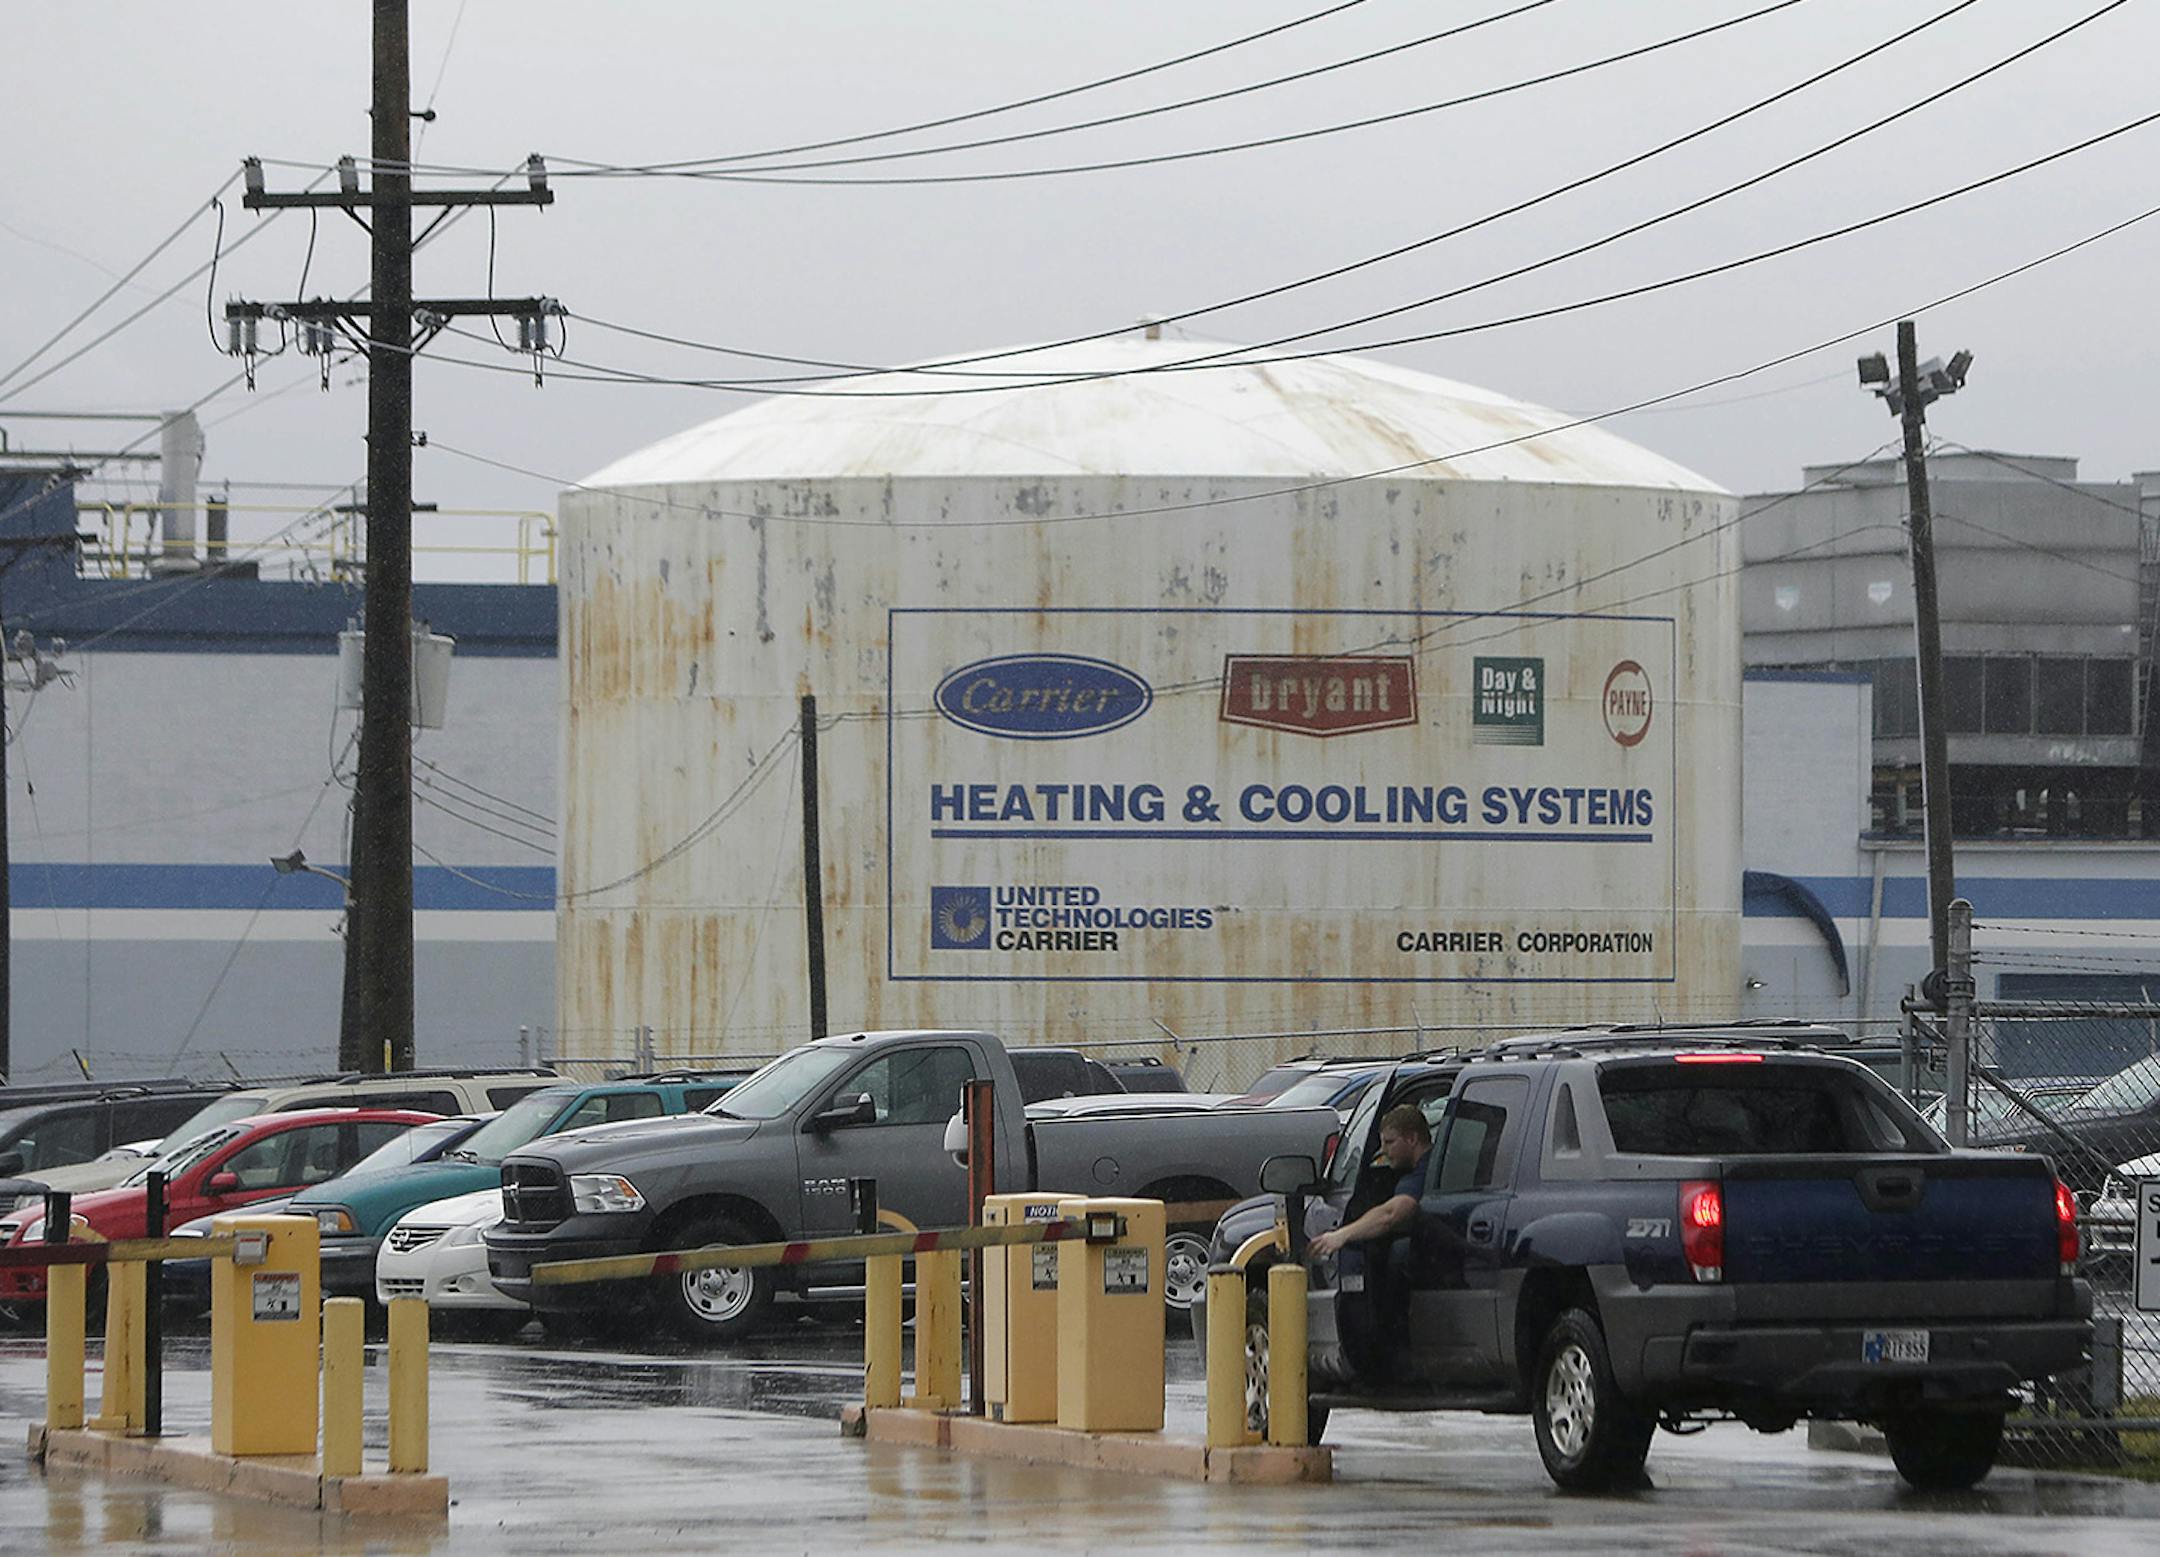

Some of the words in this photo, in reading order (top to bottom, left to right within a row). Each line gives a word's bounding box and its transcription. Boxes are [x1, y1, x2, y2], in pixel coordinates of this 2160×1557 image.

[1481, 667, 1517, 693] Day
[1522, 667, 1537, 690] &
[963, 678, 1119, 714] Carrier
[1251, 671, 1391, 719] bryant
[1481, 691, 1536, 718] Night
[1610, 690, 1647, 716] PAYNE
[931, 784, 1165, 822] HEATING
[1182, 784, 1221, 822] &
[1239, 784, 1468, 824] COOLING
[1482, 786, 1654, 826] SYSTEMS
[996, 886, 1100, 906] UNITED
[996, 908, 1214, 929] TECHNOLOGIES
[996, 931, 1119, 952] CARRIER
[1397, 931, 1504, 953] CARRIER
[1517, 932, 1654, 954] CORPORATION
[1029, 1205, 1058, 1217] NOTI
